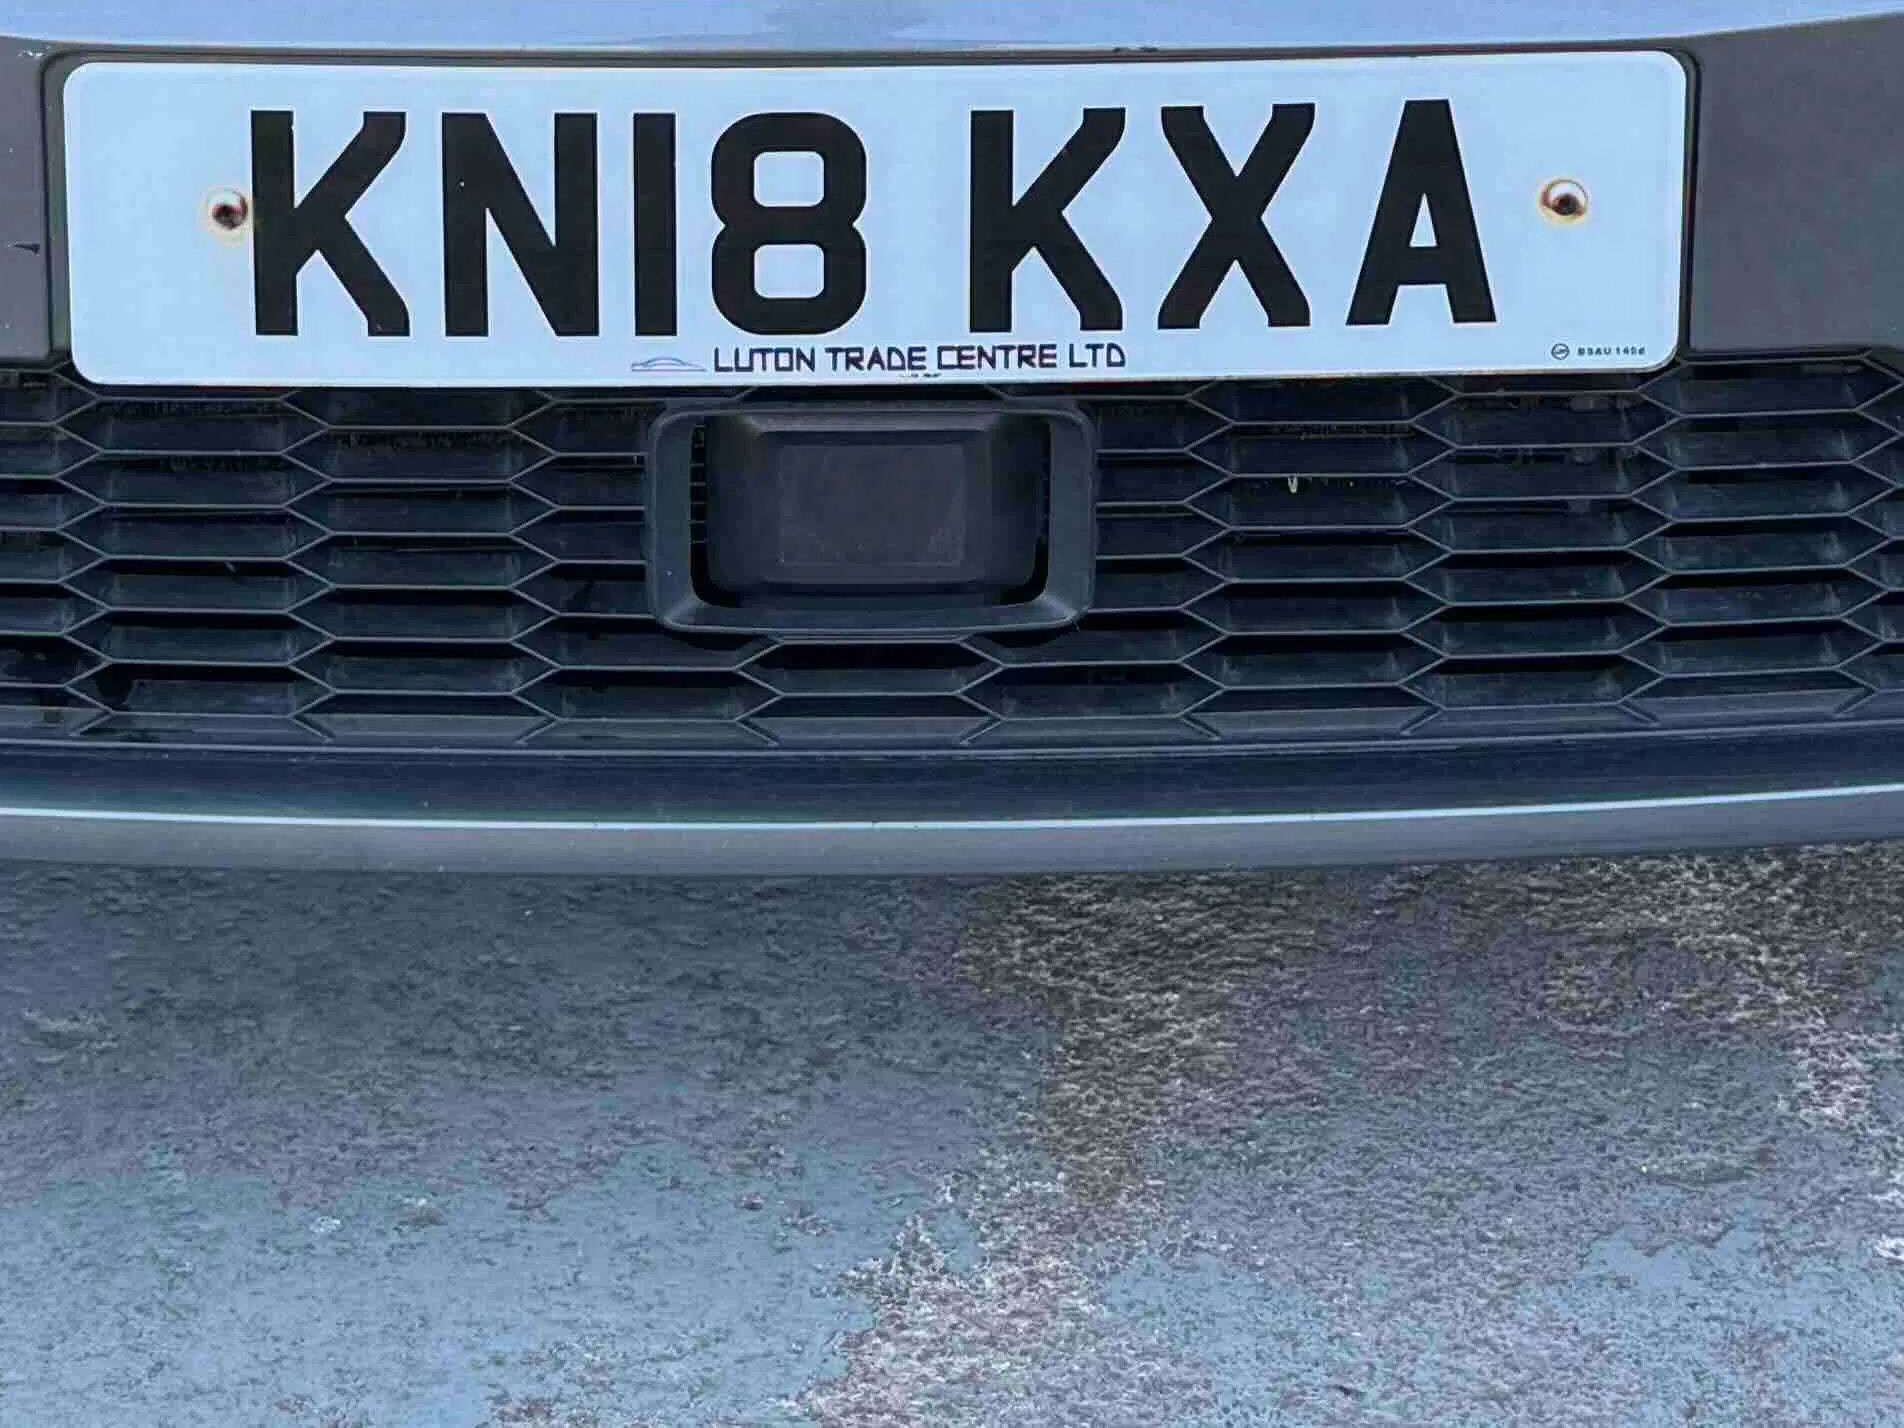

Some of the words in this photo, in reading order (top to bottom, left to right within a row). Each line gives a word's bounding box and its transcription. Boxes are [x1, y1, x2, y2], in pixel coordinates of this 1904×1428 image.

[249, 109, 867, 338] KN18
[968, 98, 1498, 334] KXA
[713, 346, 817, 373] LUTON
[824, 345, 927, 371] TRADE
[936, 343, 1057, 370] CENTRE
[1068, 342, 1126, 368] LTD
